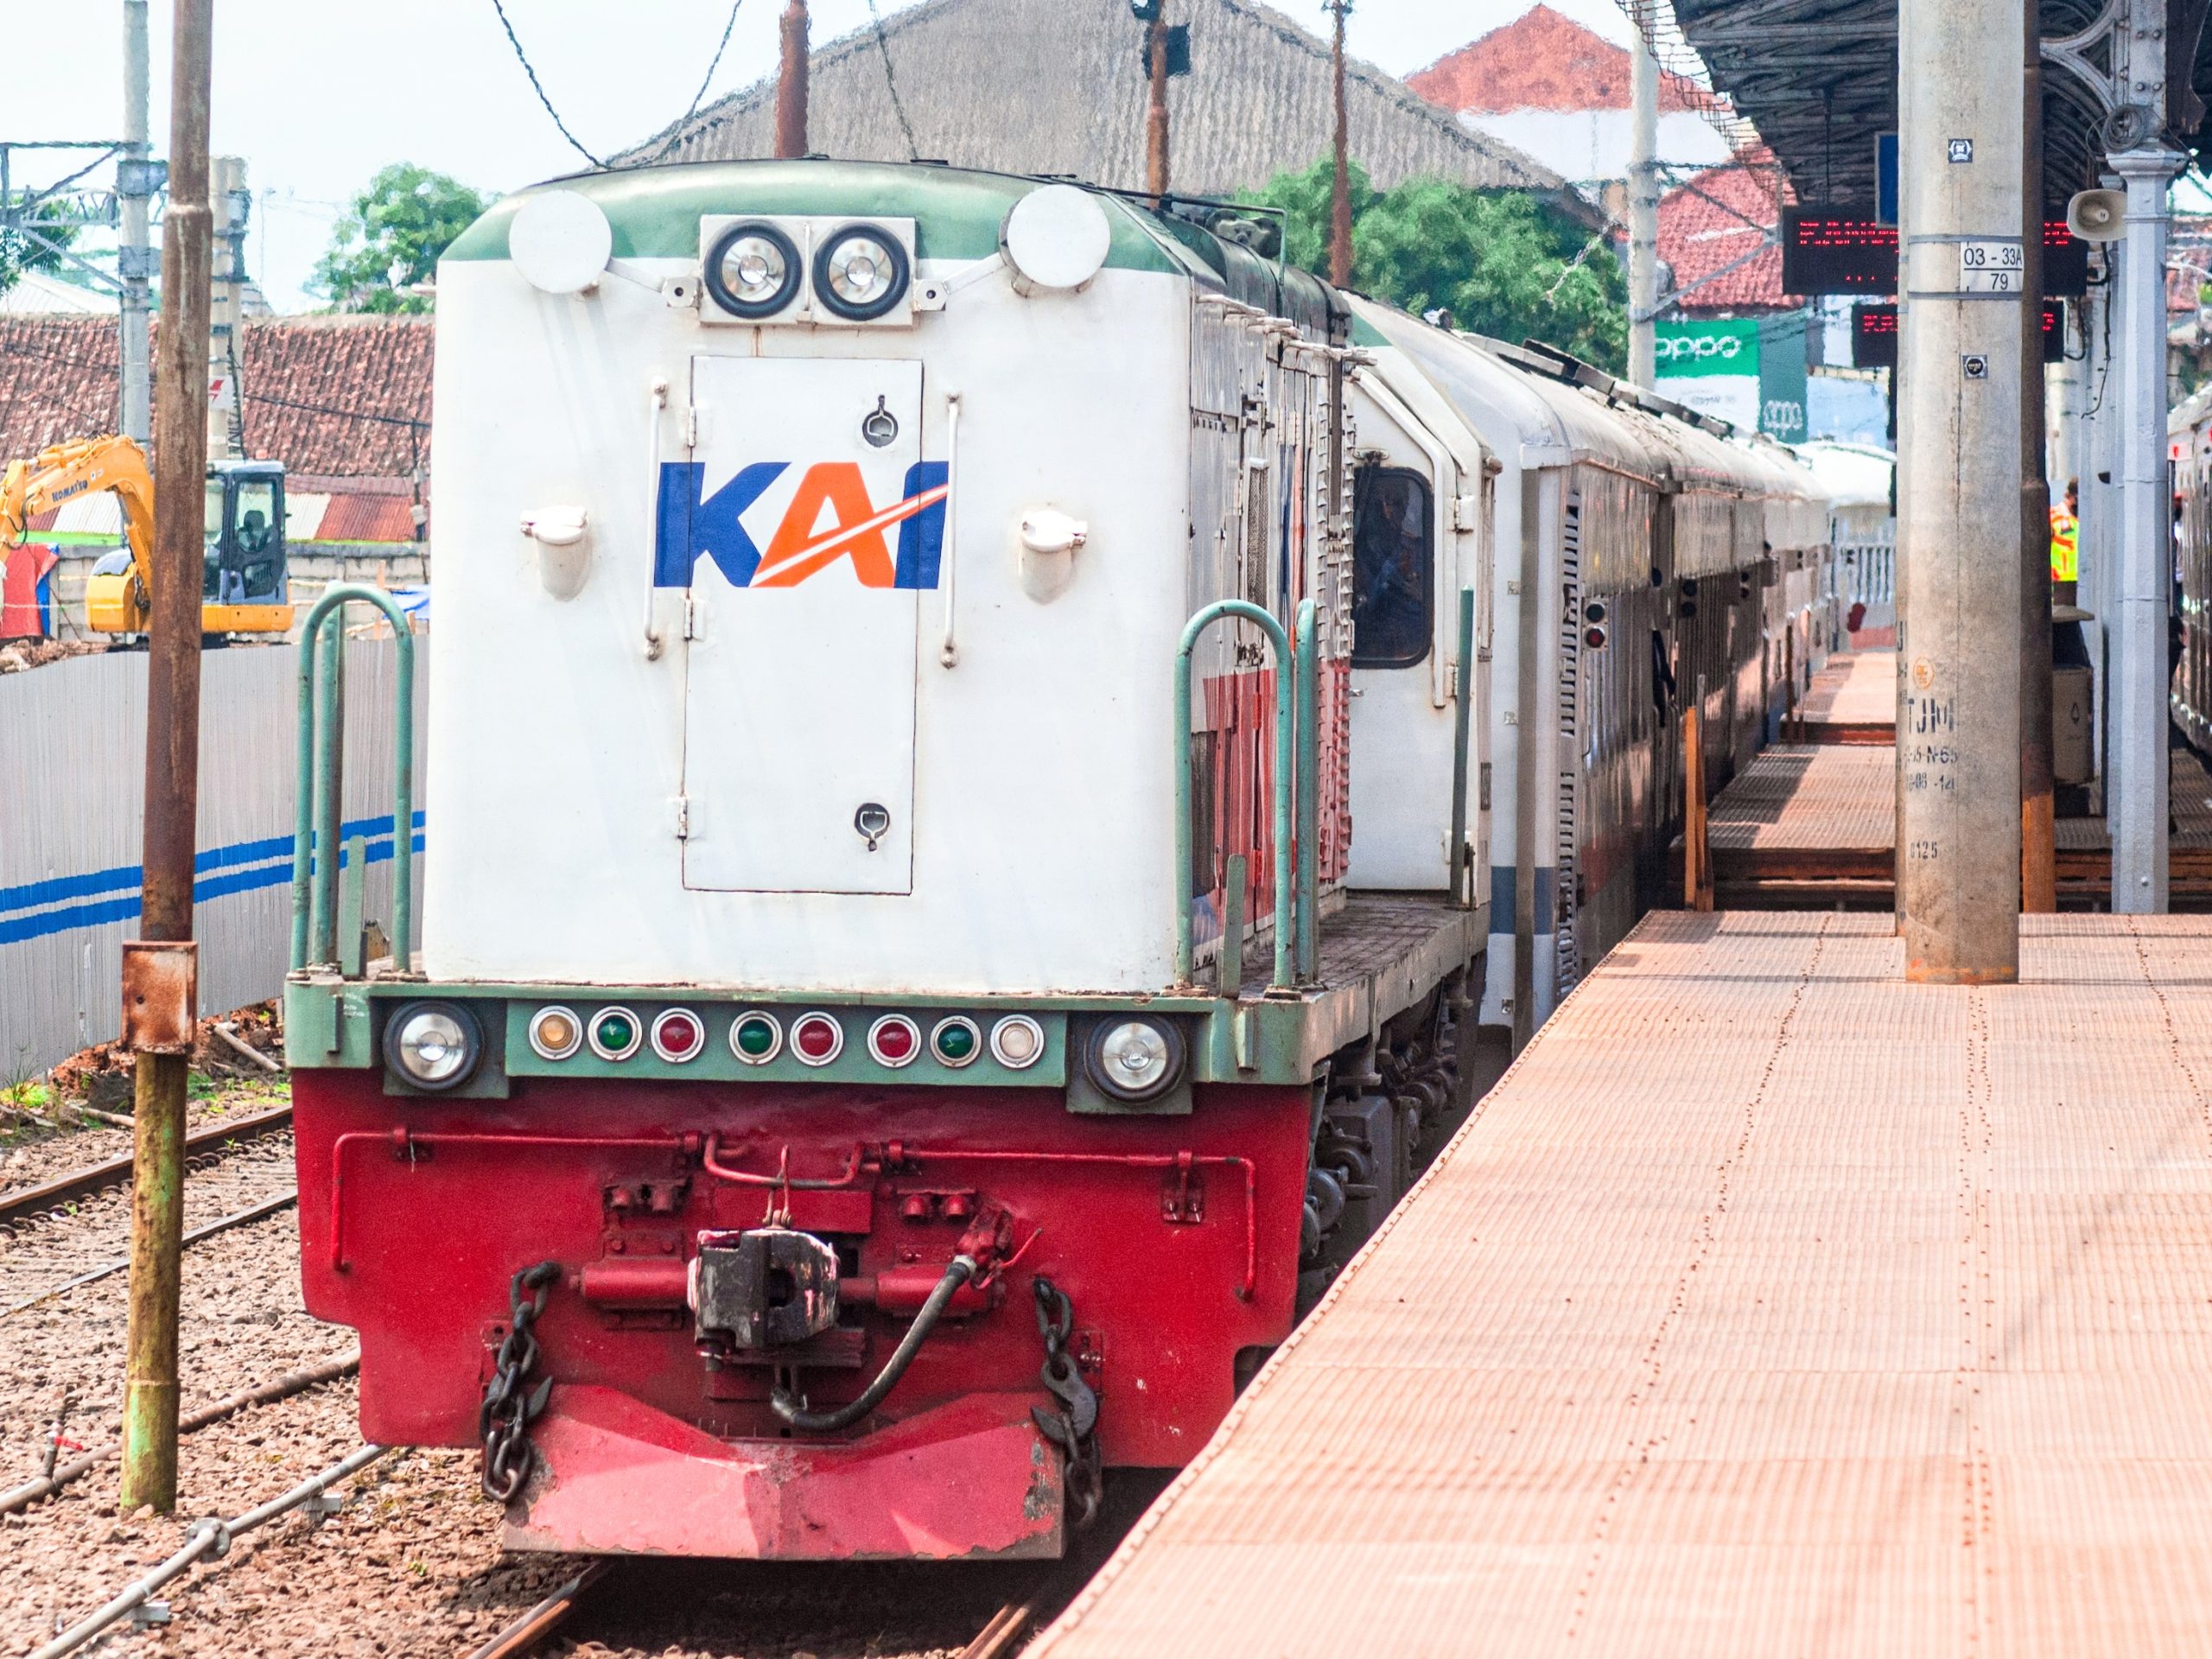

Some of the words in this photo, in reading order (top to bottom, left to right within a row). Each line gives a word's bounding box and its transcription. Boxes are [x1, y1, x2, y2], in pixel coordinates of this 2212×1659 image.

[1964, 248, 1986, 265] 03
[2002, 247, 2022, 266] 33A
[1991, 273, 2008, 290] 79
[52, 480, 88, 502] KOMATSU
[654, 461, 949, 588] KAI
